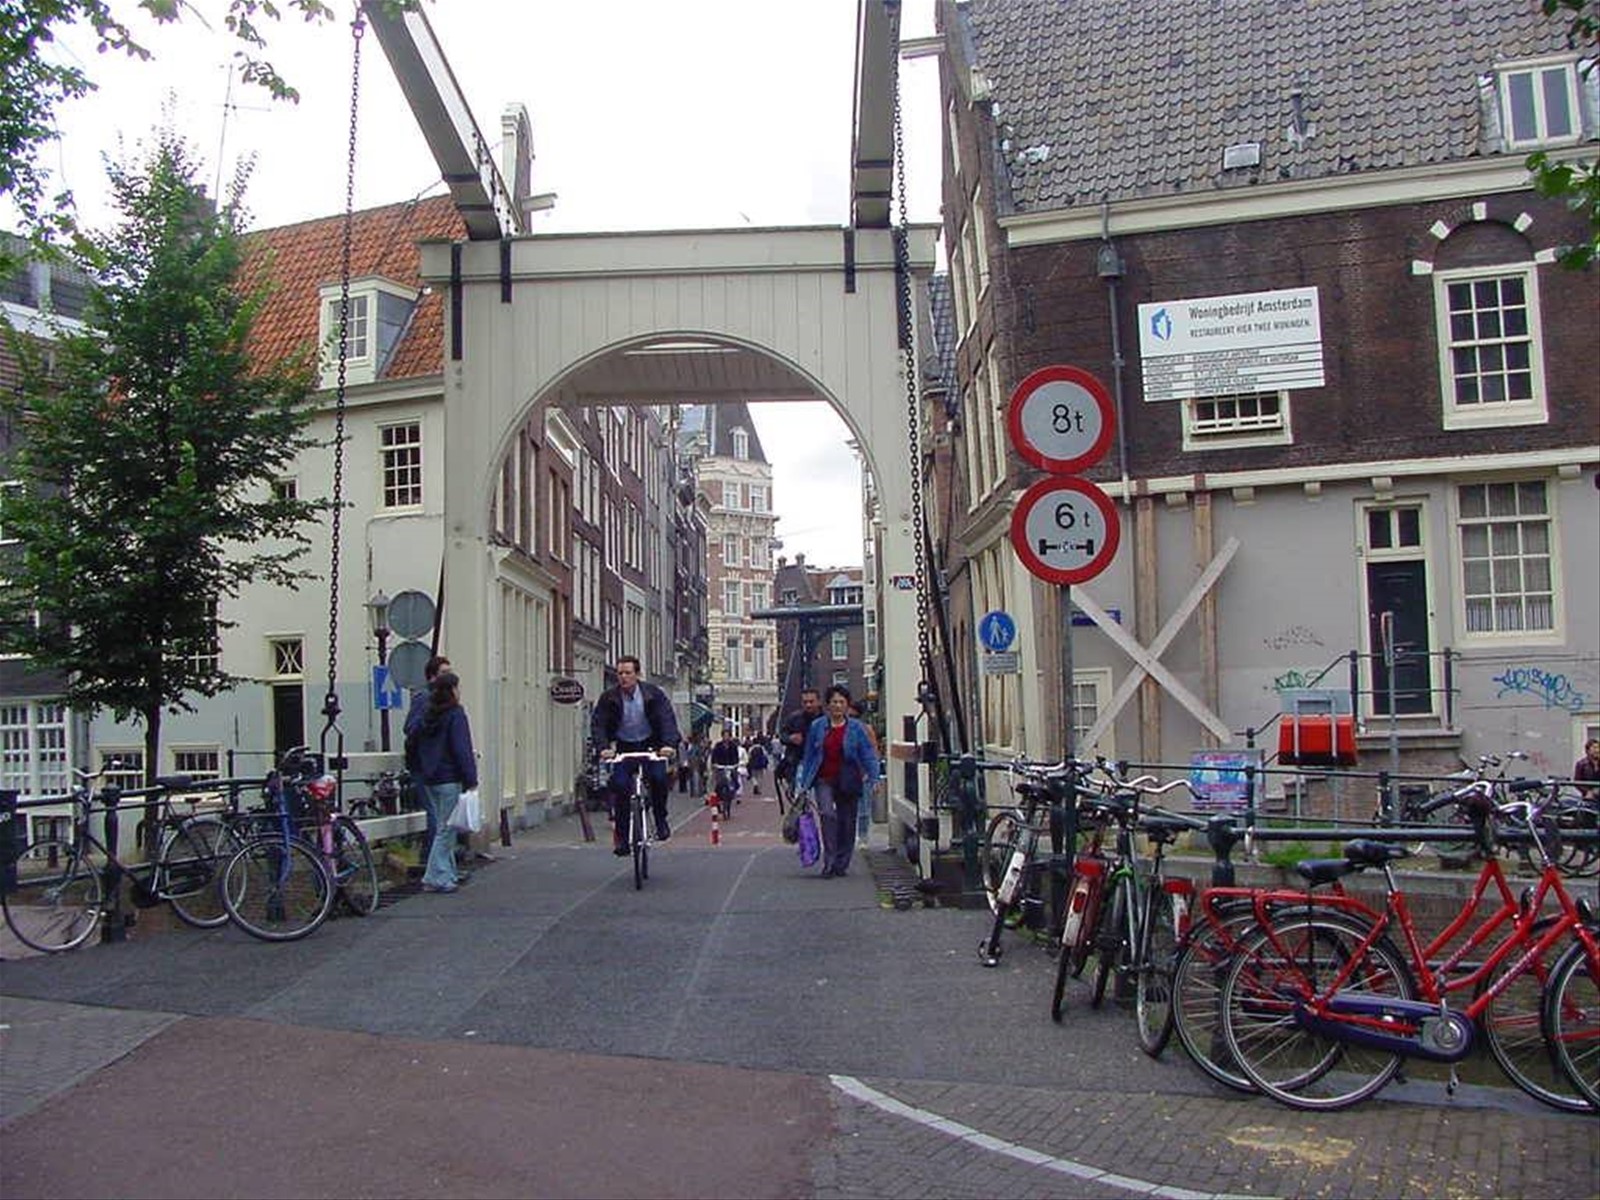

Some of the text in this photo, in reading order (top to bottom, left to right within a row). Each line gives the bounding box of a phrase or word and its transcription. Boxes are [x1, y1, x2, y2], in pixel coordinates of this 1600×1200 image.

[1189, 298, 1312, 319] Woningbedrijf Amsterdam
[1236, 323, 1252, 334] HIER
[1254, 322, 1271, 332] TWEE
